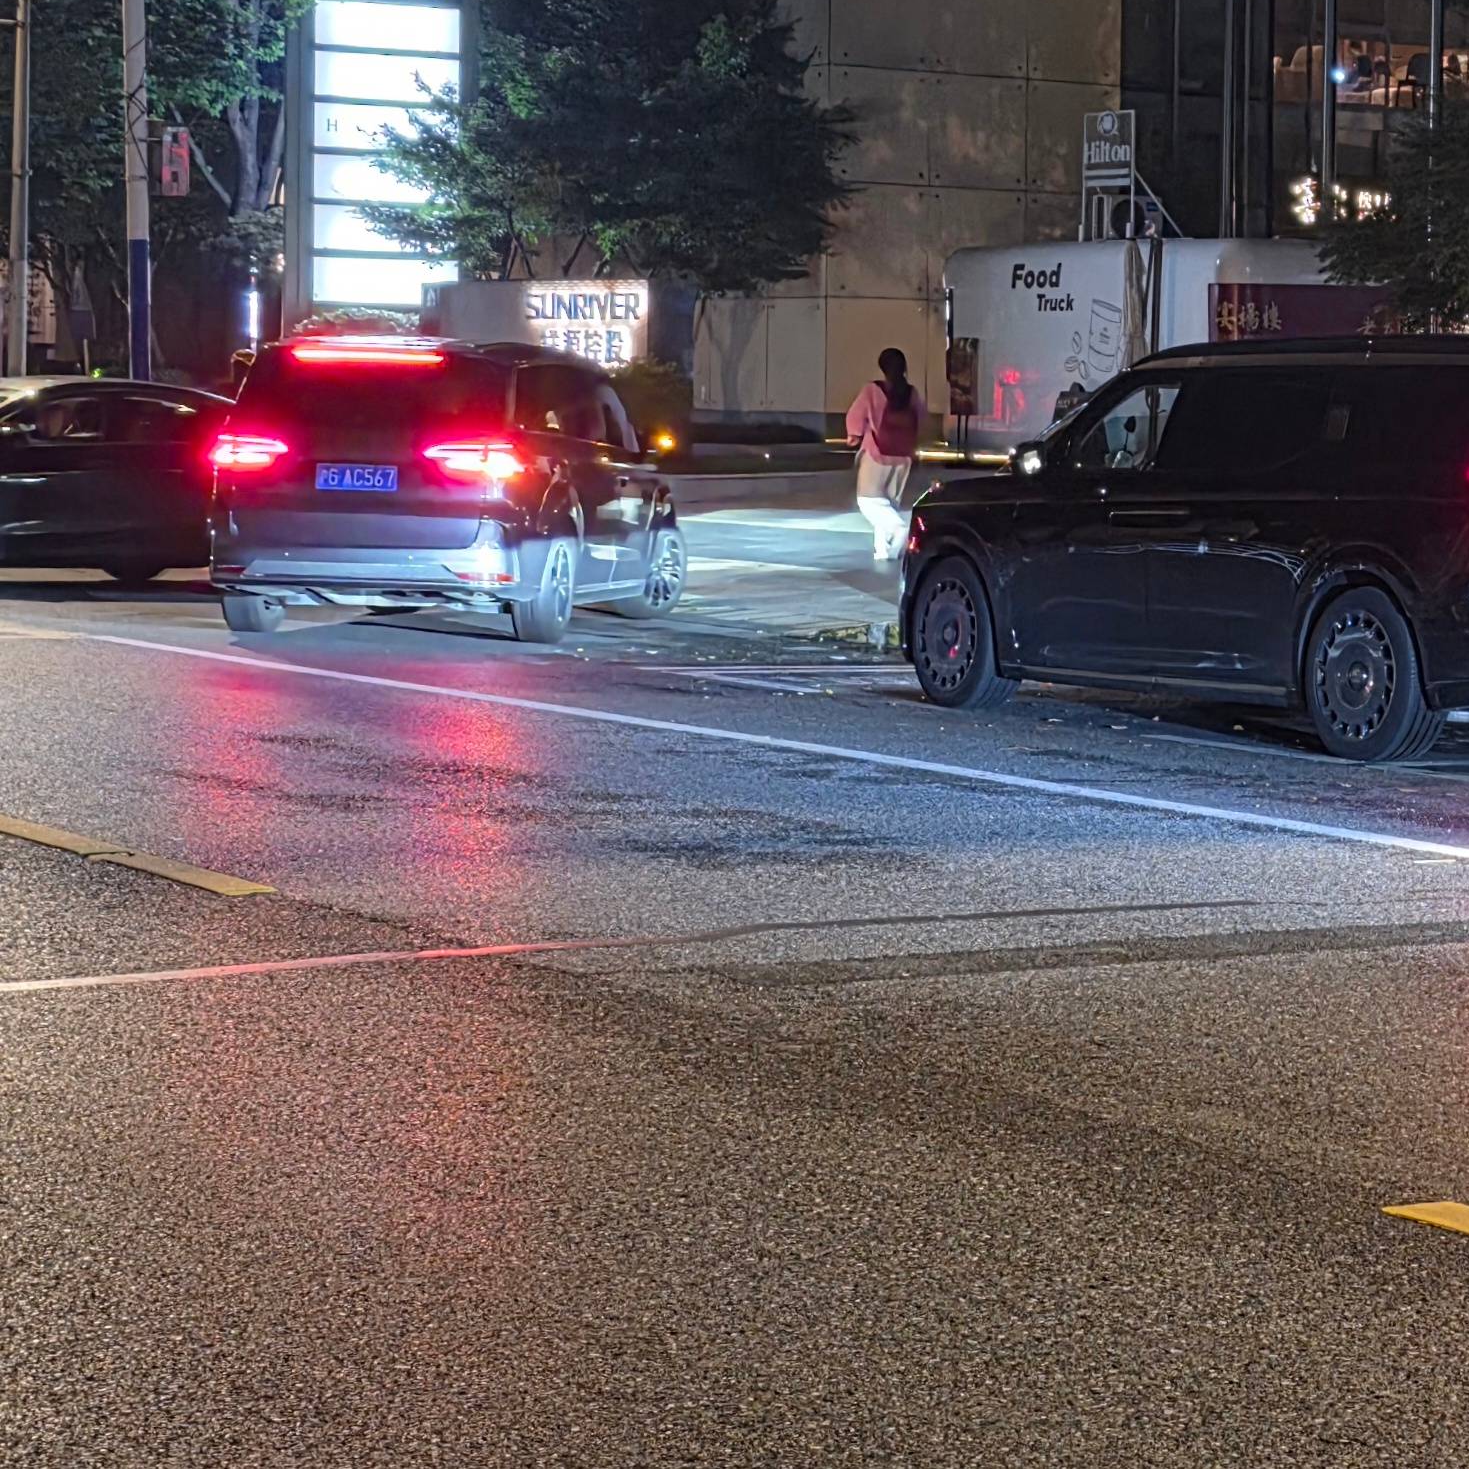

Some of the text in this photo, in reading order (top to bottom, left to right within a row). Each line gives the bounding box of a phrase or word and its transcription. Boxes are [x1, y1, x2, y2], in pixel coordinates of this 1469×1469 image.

[1083, 140, 1131, 164] Hilton
[1011, 262, 1062, 289] Food
[526, 291, 641, 320] SUNRIVER
[1037, 293, 1075, 312] Truck
